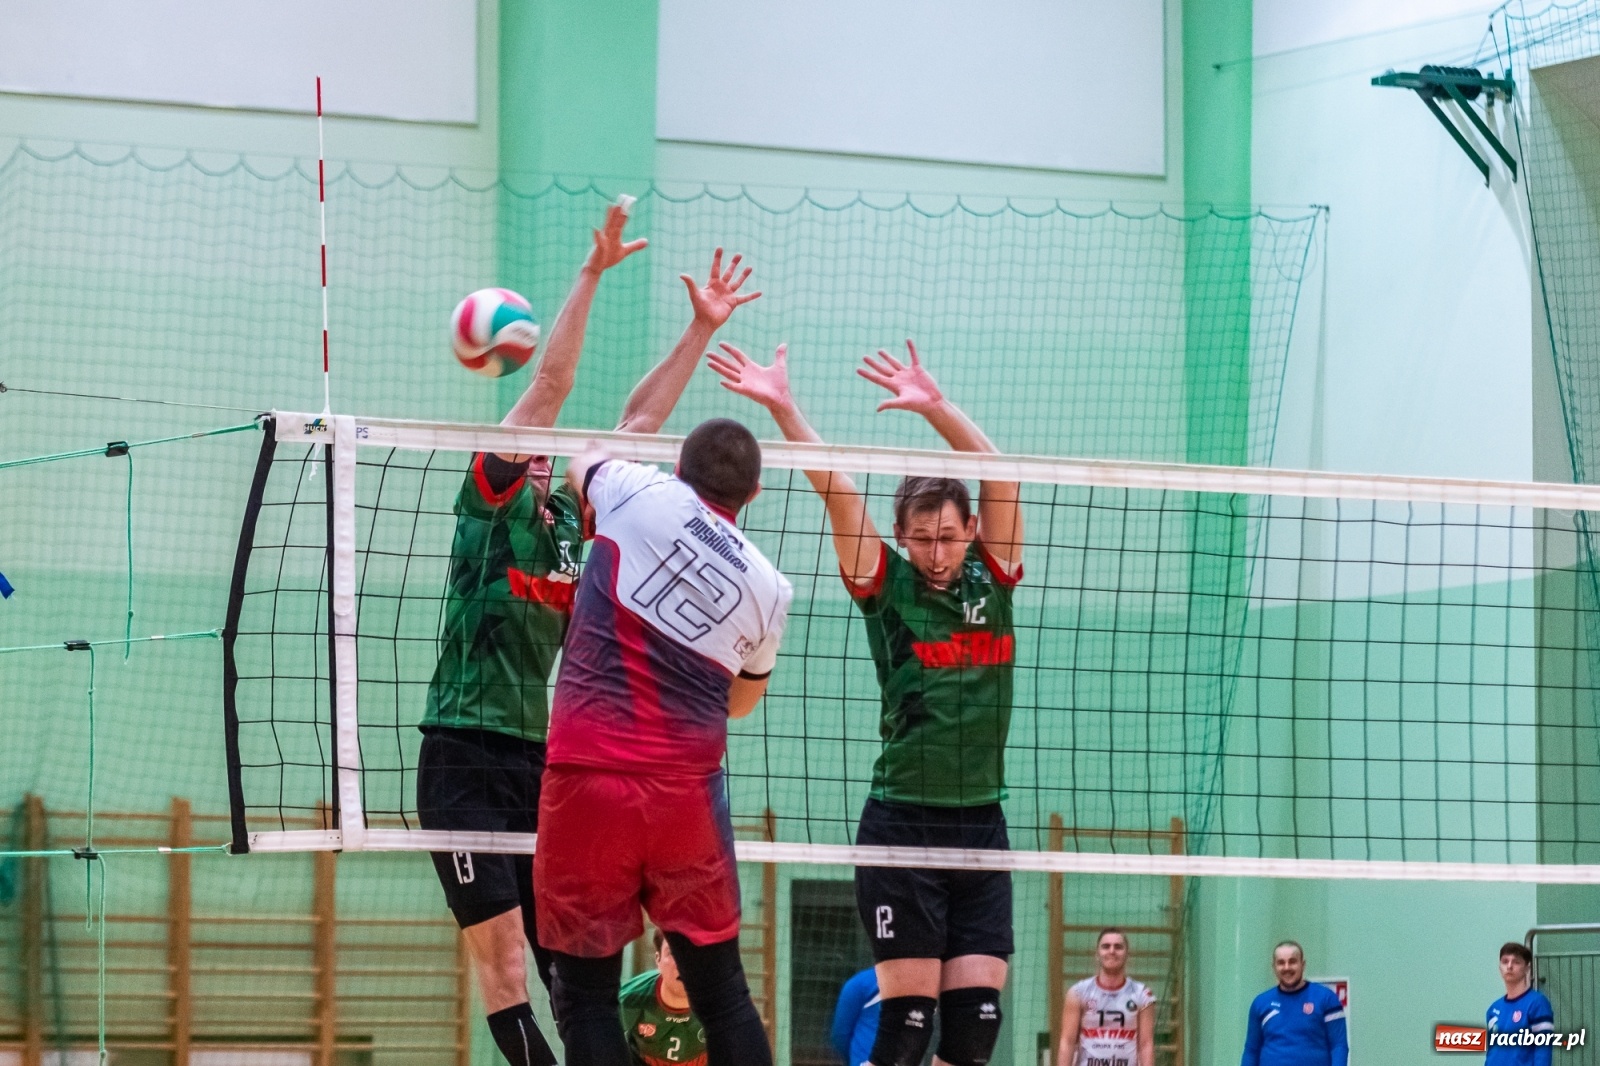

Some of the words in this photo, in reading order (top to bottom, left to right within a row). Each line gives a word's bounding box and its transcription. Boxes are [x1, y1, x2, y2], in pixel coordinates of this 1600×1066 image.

[631, 539, 742, 642] 12
[875, 905, 895, 939] 12
[666, 1036, 681, 1061] 2
